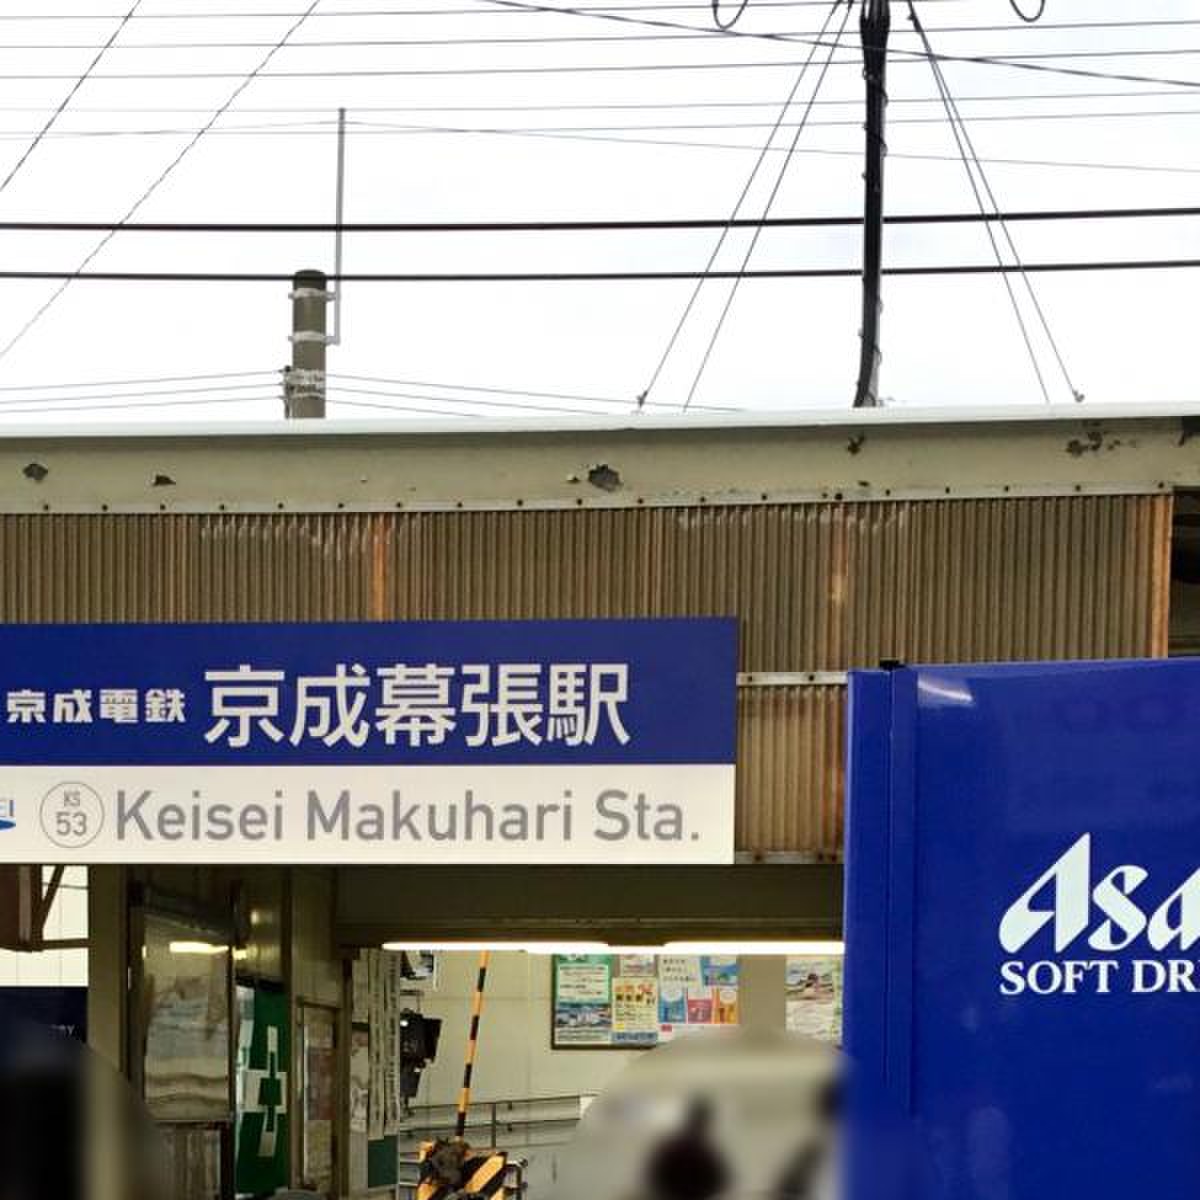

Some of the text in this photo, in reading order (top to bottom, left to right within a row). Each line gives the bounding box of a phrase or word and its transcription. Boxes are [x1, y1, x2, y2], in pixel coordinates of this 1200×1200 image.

[6, 663, 632, 748] 京成電鉄 京成幕張駅
[55, 811, 88, 837] 53
[116, 788, 700, 842] Keisei Makuhari Sta.
[998, 832, 1200, 953] Asa
[1000, 959, 1200, 994] SOFT DR
